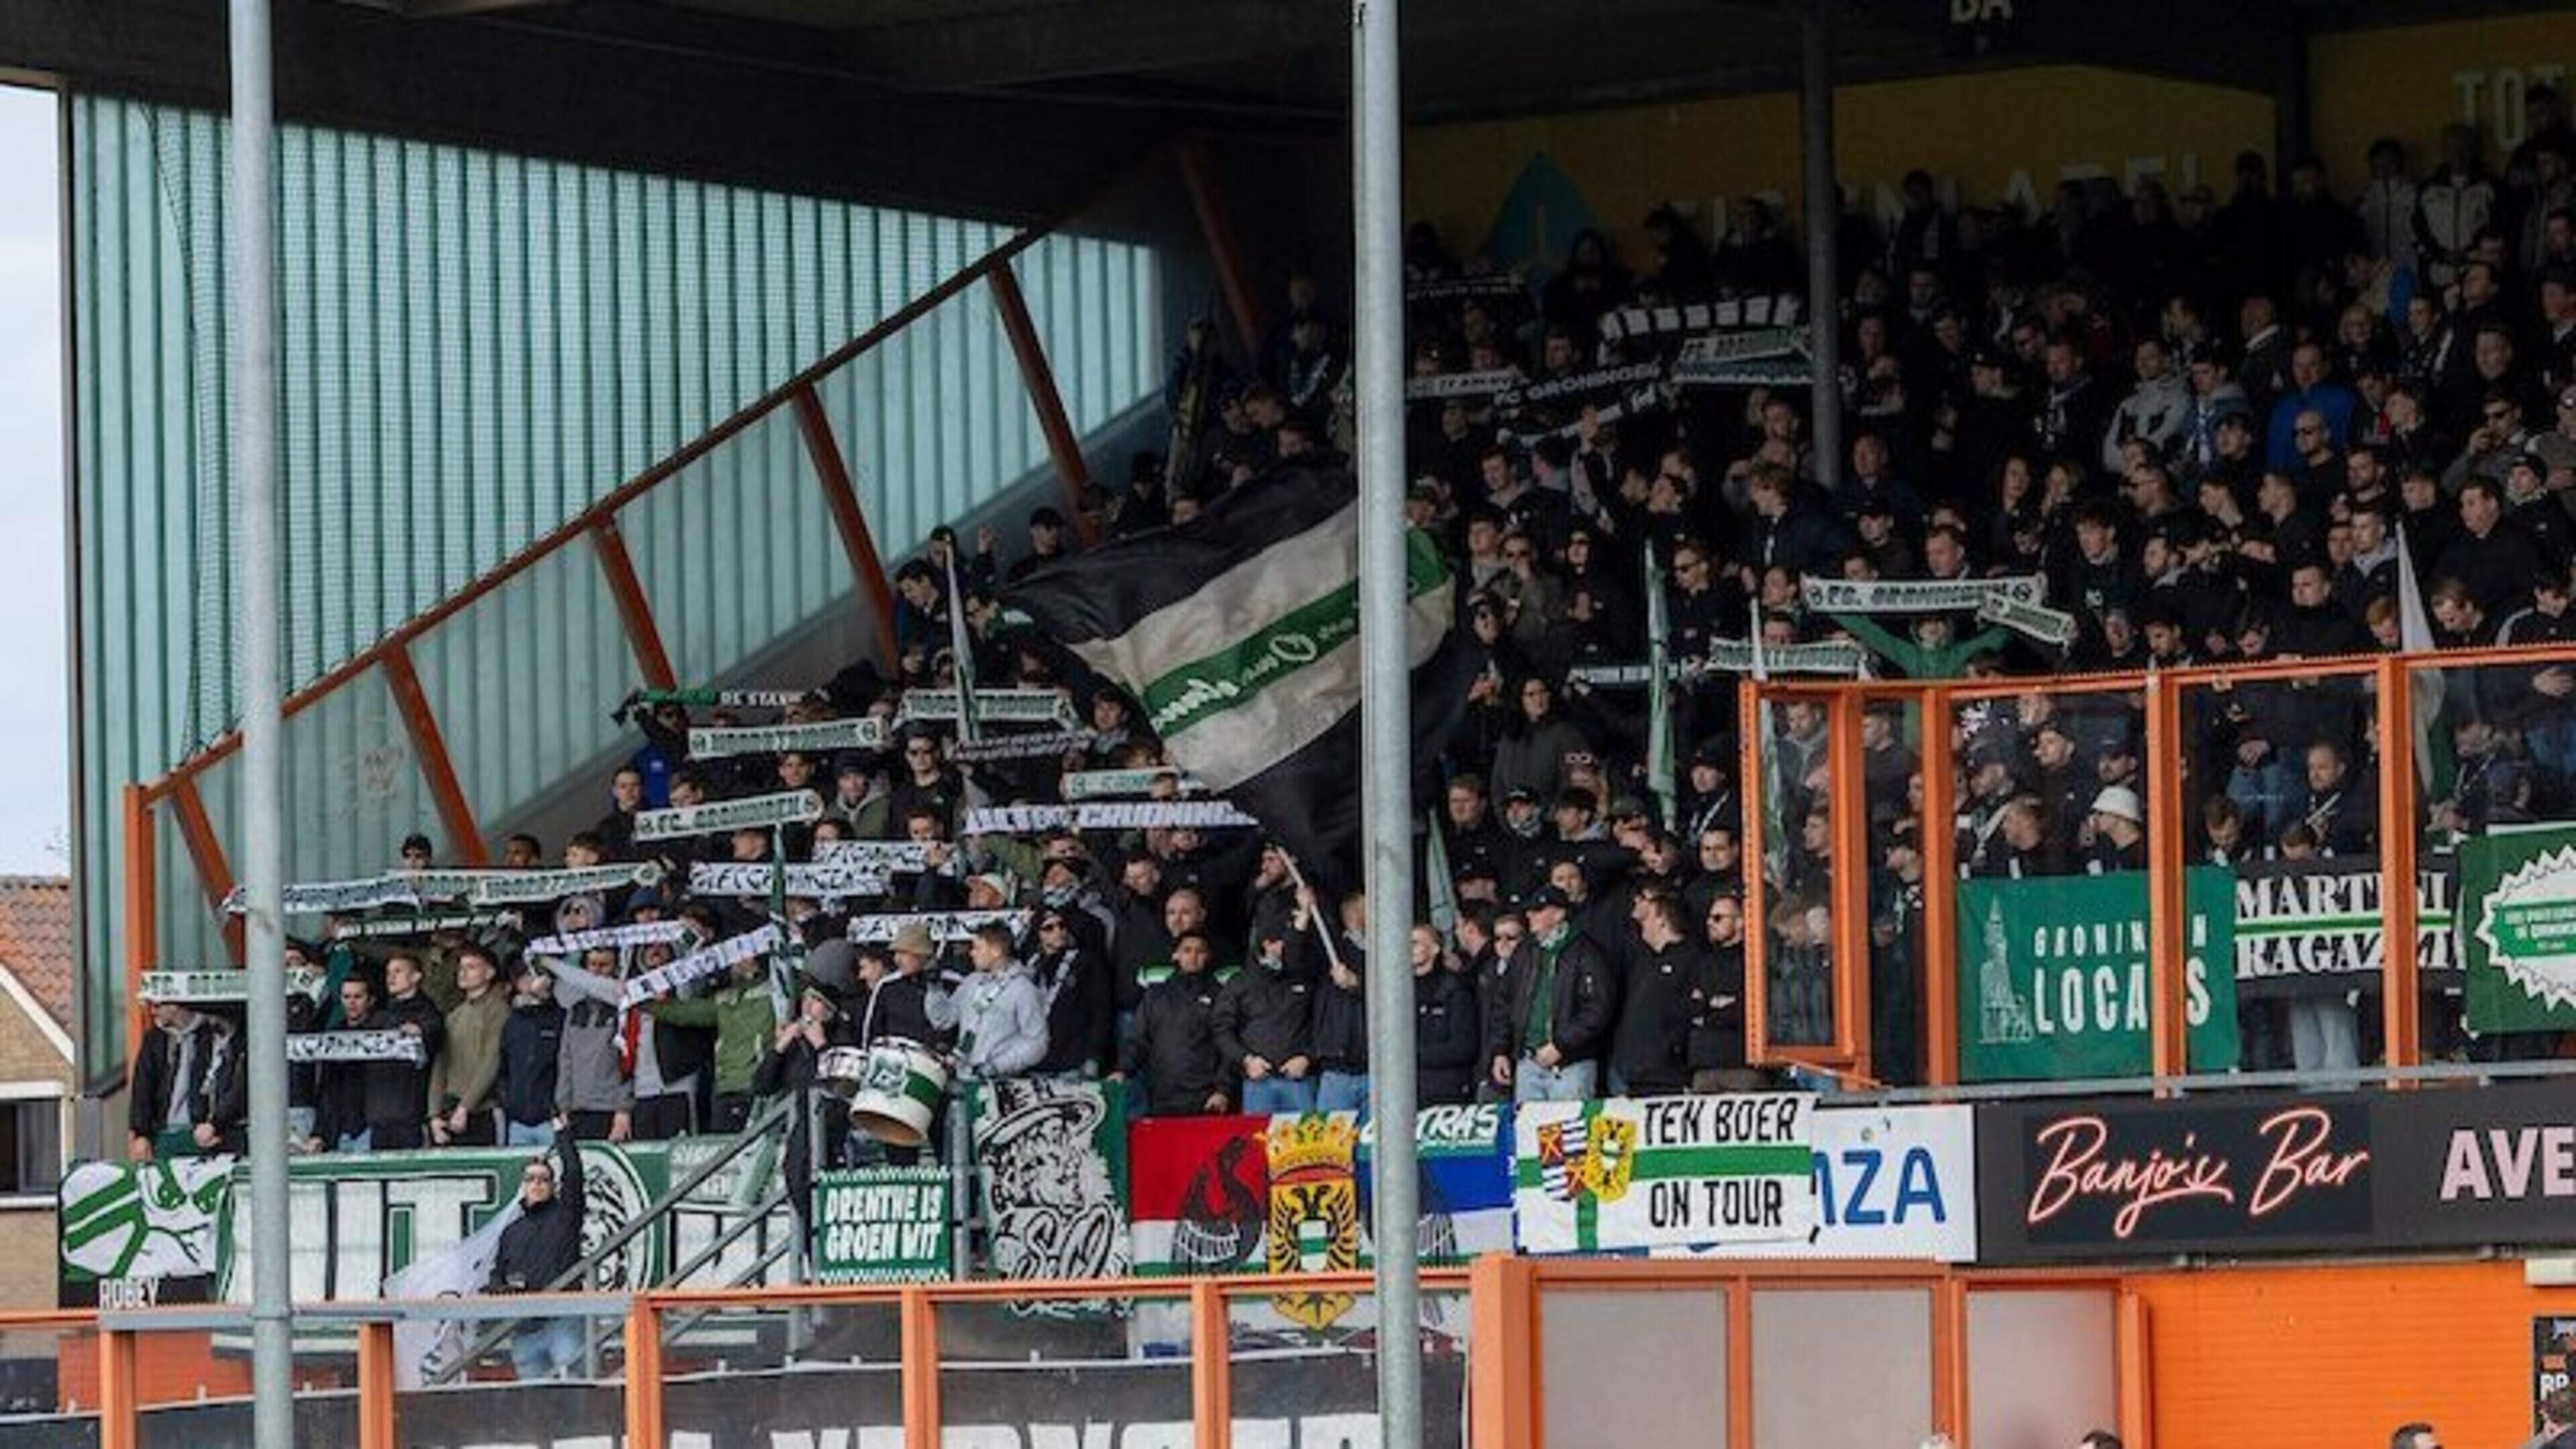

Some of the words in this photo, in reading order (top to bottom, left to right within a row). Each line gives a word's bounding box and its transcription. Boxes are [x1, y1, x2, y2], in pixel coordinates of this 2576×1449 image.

[2236, 871, 2450, 919] MARTI
[2035, 914, 2207, 957] GRONINN
[2035, 957, 2210, 1034] LOCAS
[1644, 1099, 1705, 1144] TEN
[1715, 1097, 1800, 1142] BOER
[2027, 1116, 2235, 1238] Banjo's
[2249, 1106, 2369, 1215] Bar
[824, 1185, 918, 1223] DRENTHE
[920, 1184, 944, 1220] IS
[1650, 1181, 1690, 1228] ON
[1704, 1179, 1783, 1227] TOUR
[825, 1222, 898, 1262] GROEN
[901, 1222, 943, 1260] WIT
